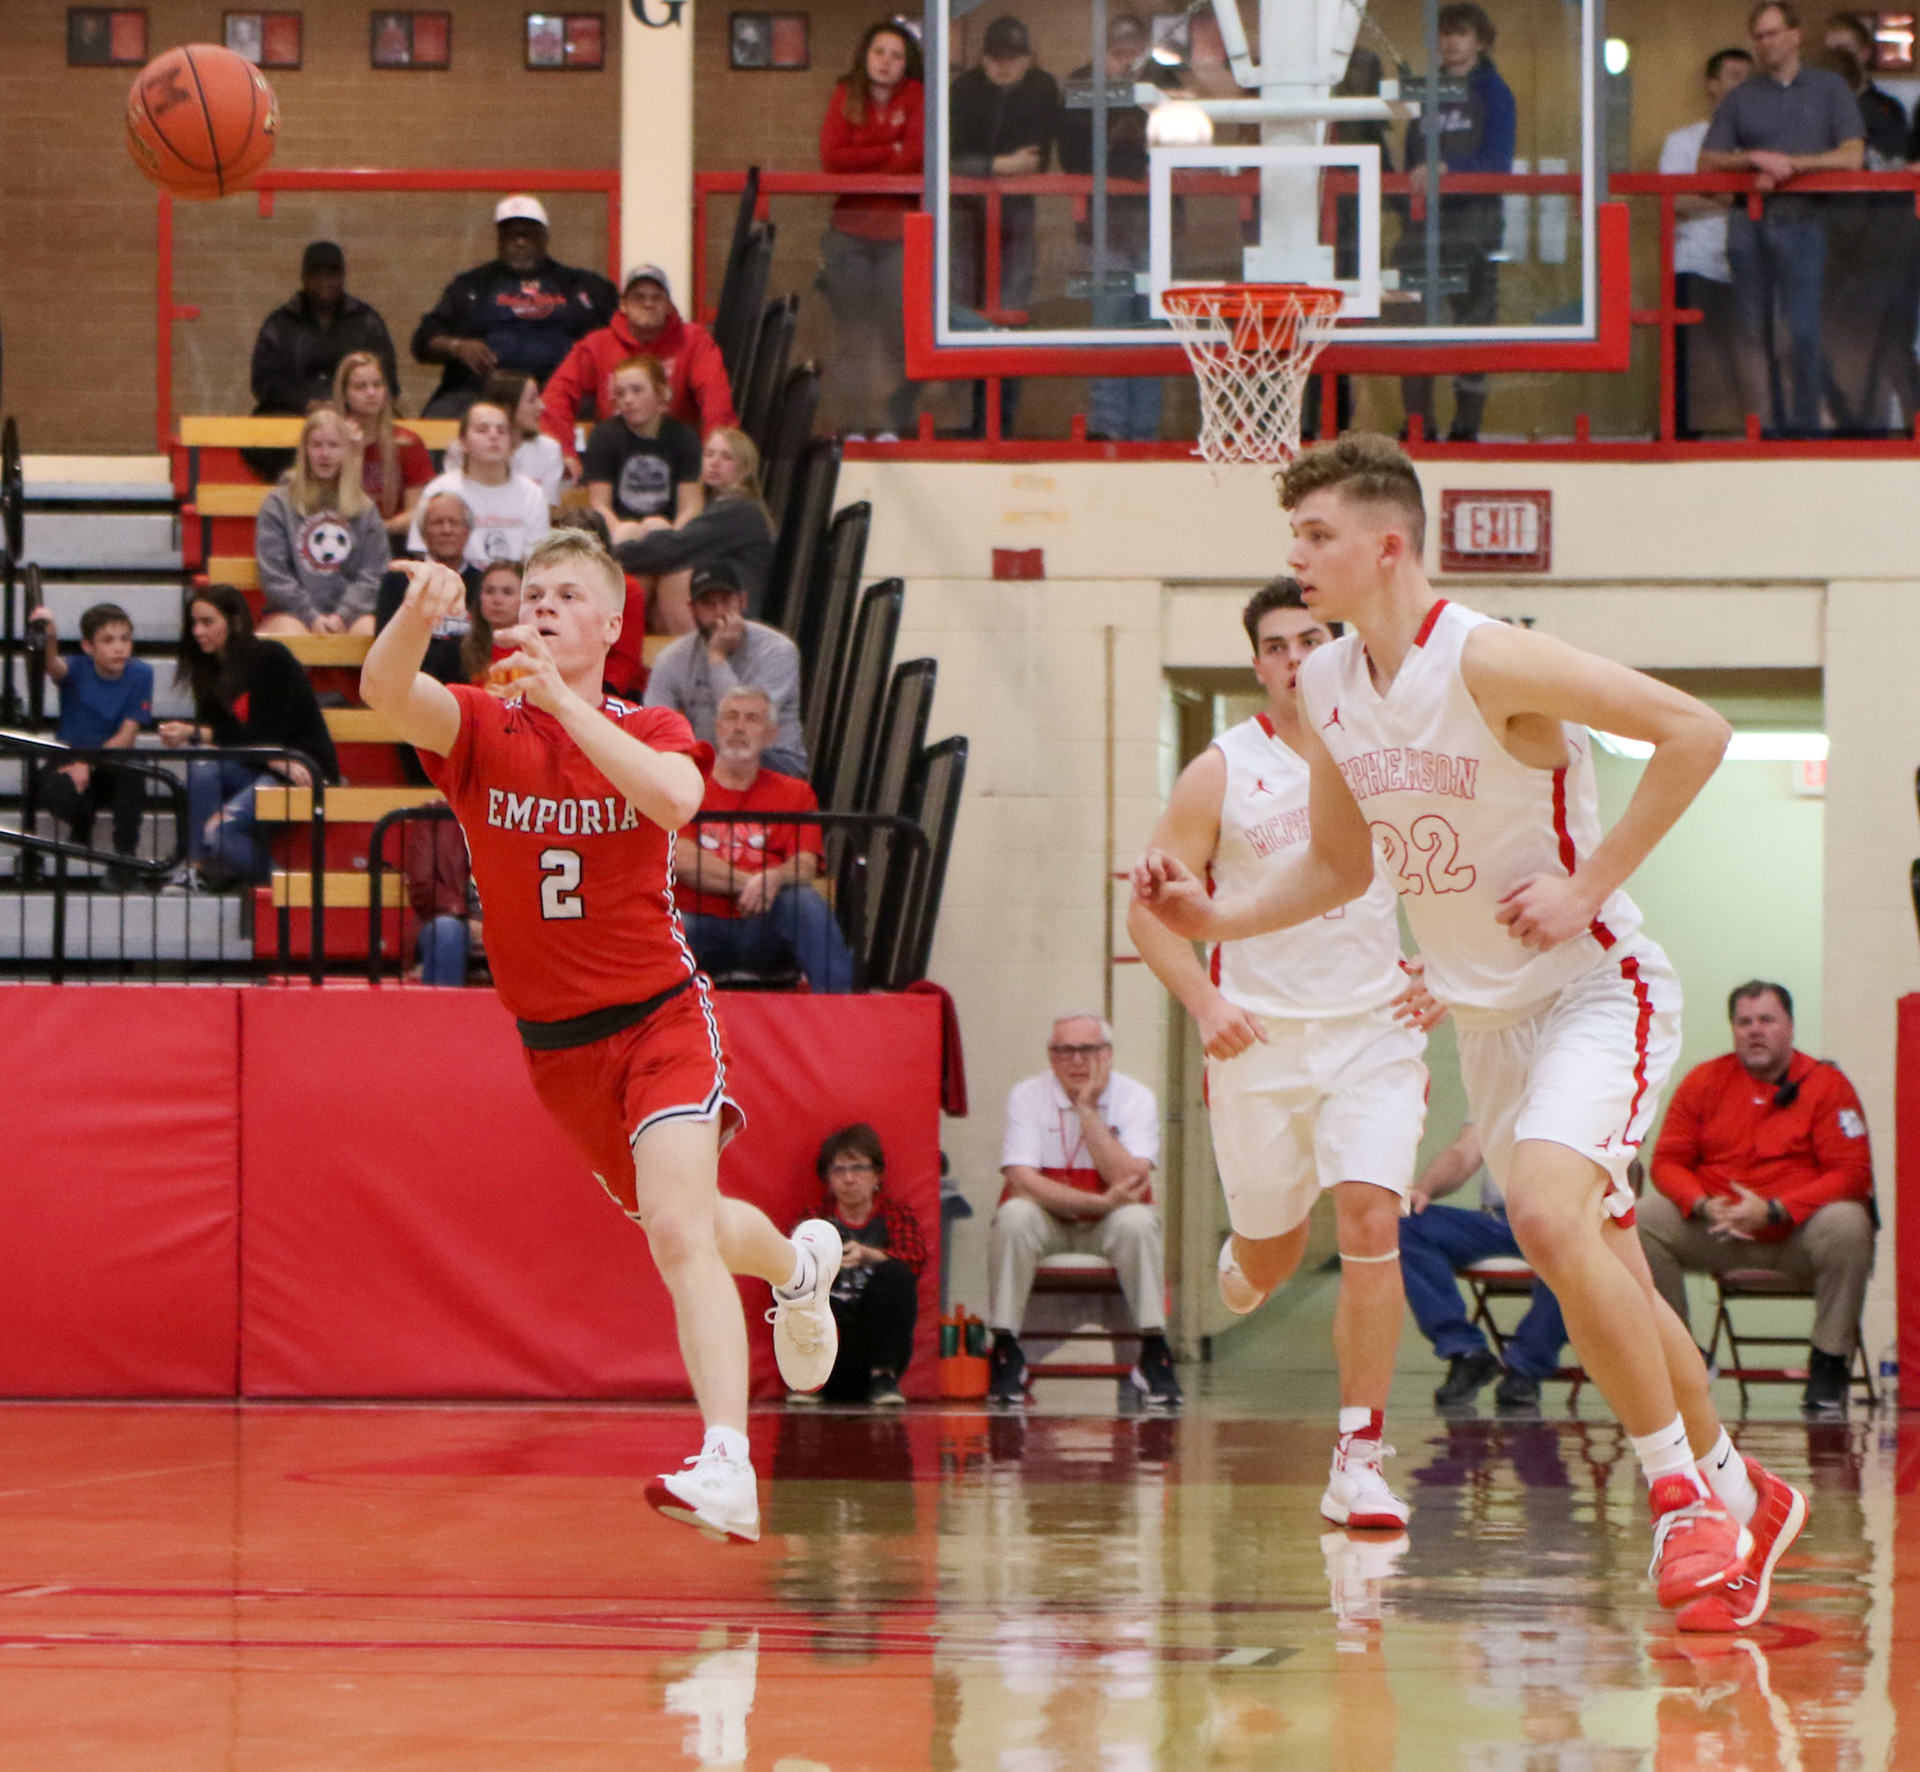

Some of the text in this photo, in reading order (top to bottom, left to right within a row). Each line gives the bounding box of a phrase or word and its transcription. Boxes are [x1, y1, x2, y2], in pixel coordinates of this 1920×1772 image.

[1470, 506, 1525, 549] EXIT
[487, 787, 640, 835] EMPORIA
[539, 846, 585, 920] 2
[1369, 814, 1476, 896] 22
